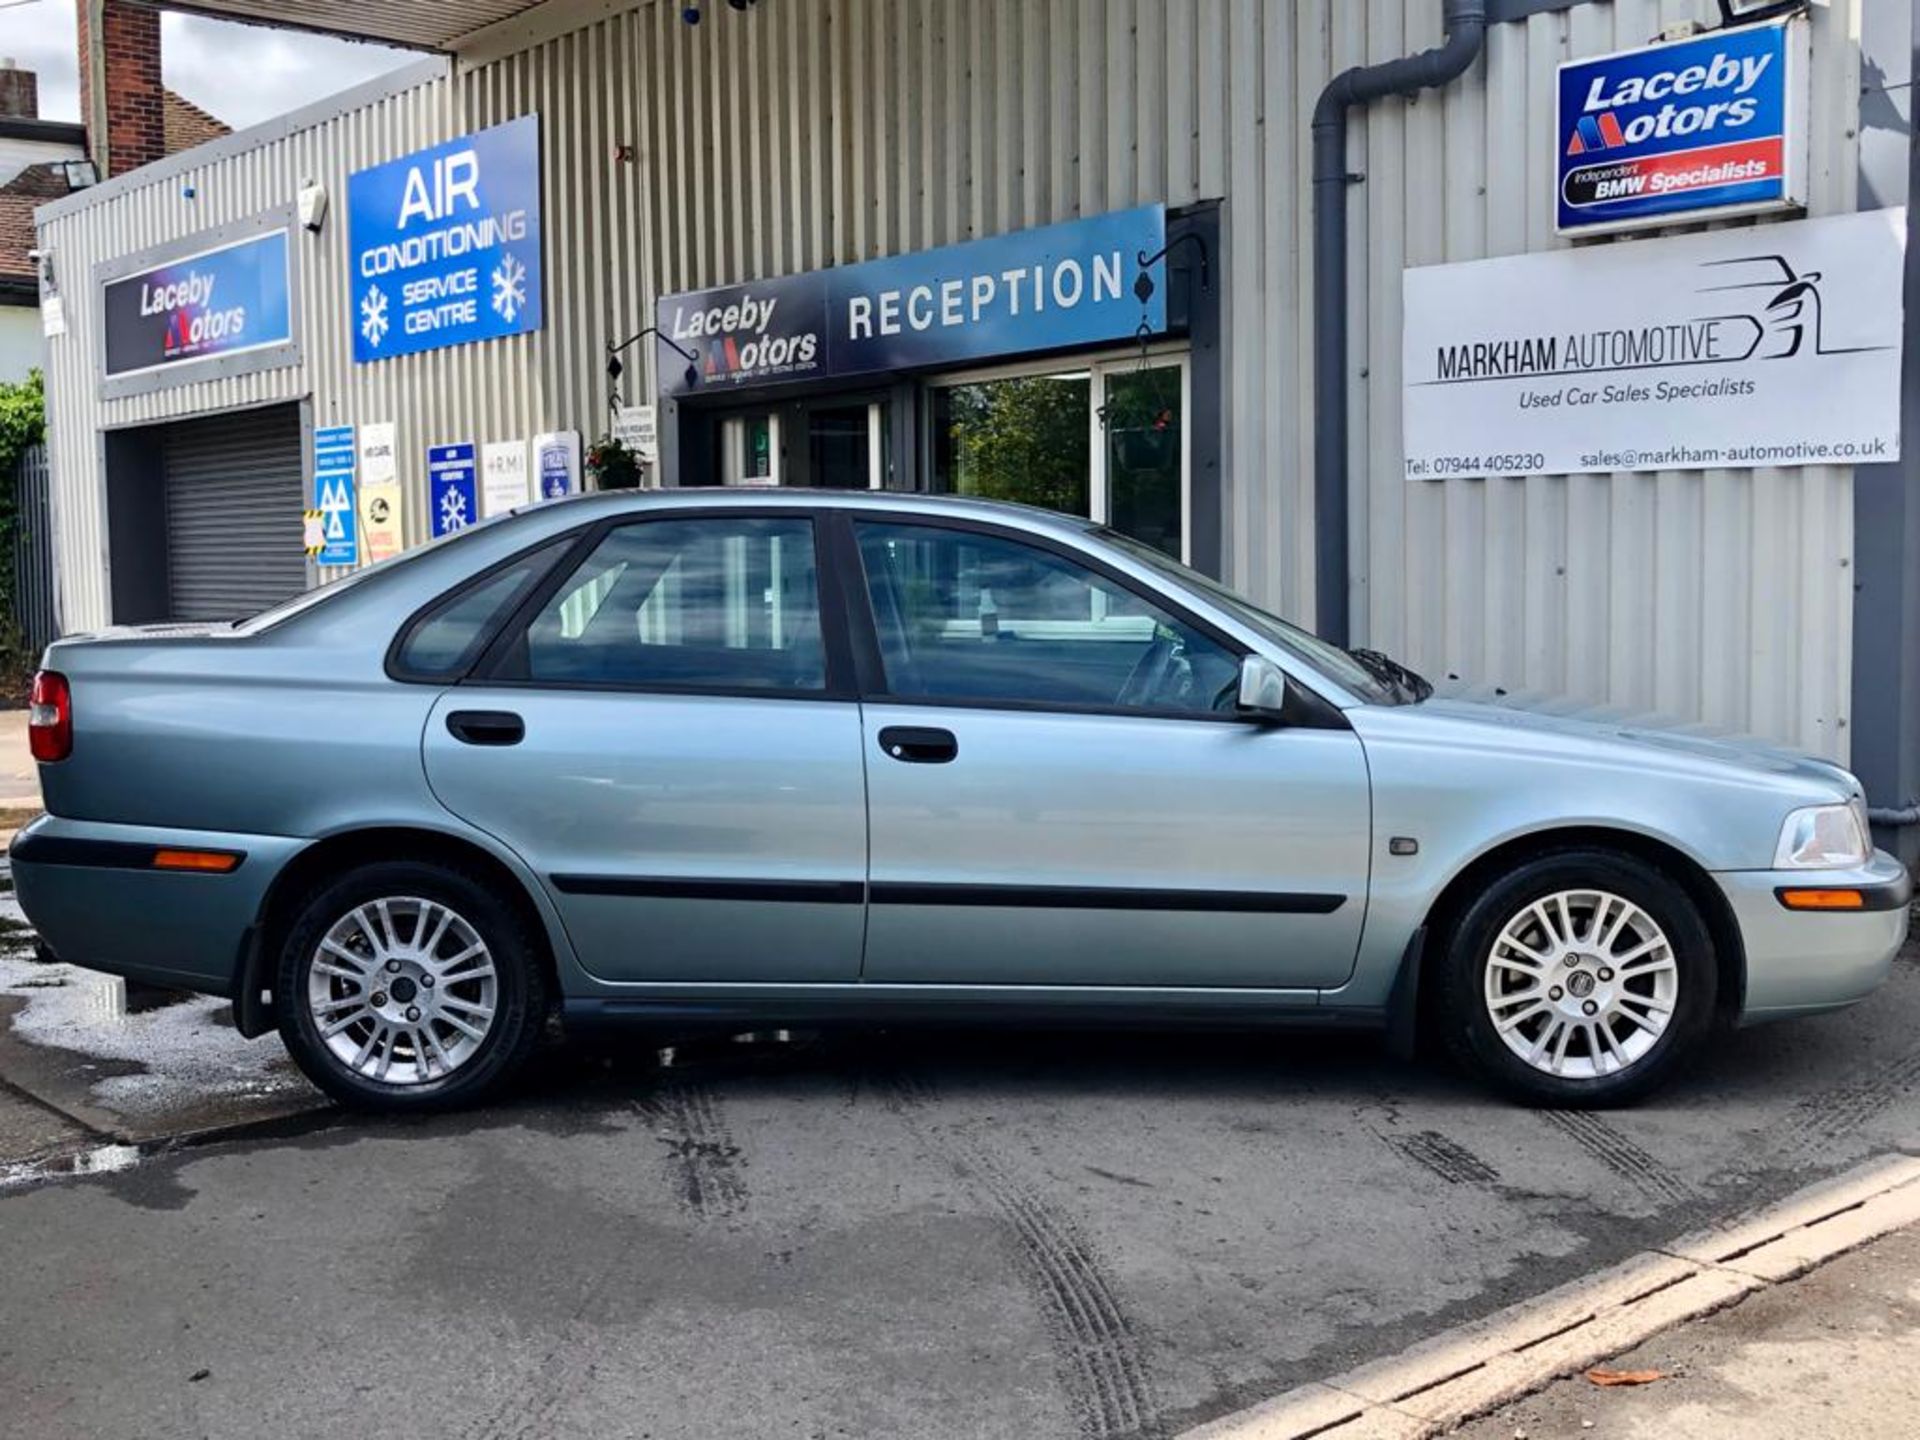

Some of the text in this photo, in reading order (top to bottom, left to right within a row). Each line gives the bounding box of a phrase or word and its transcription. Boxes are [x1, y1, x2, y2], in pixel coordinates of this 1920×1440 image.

[1584, 52, 1774, 112] Laceby
[1566, 97, 1758, 155] Motors
[397, 149, 480, 229] AIR
[1574, 164, 1639, 184] Independent
[1594, 159, 1766, 200] BMW Specialists
[361, 209, 526, 278] CONDITIONING
[140, 270, 215, 316] Laceby
[403, 268, 478, 306] SERVICE
[849, 251, 1122, 340] RECEPTION
[405, 299, 477, 334] CENTRE
[673, 294, 777, 340] Laceby
[704, 333, 817, 374] Motors
[1437, 322, 1722, 379] MARKHAM AUTOMOTIVE
[1520, 377, 1756, 409] Used Car Sales Specialists
[1406, 453, 1544, 475] Tel: 07944 405230
[1580, 438, 1886, 468] sales@markham-automotive.co.uk
